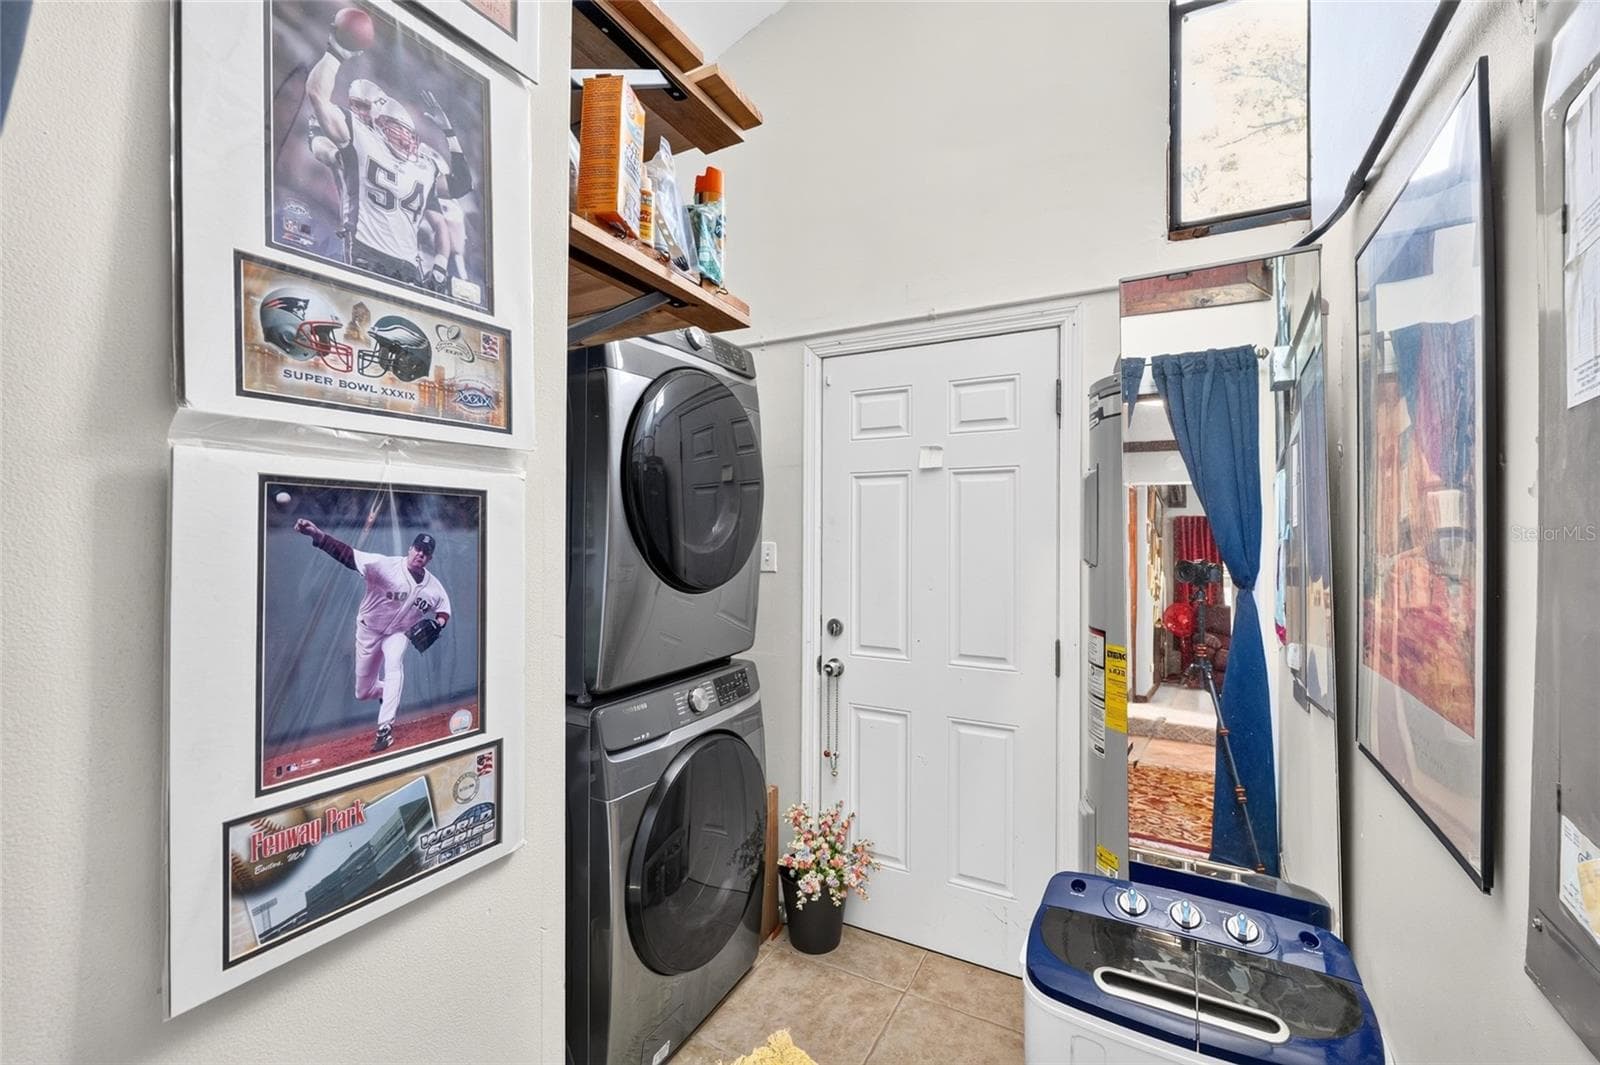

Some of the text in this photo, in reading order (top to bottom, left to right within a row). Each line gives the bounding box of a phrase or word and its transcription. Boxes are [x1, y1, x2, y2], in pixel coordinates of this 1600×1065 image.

[366, 157, 424, 222] 54
[283, 368, 416, 400] SUPER BOWL XXXIX
[249, 799, 367, 863] Fenway Park
[420, 808, 494, 850] WORLD
[425, 819, 495, 859] SERIES
